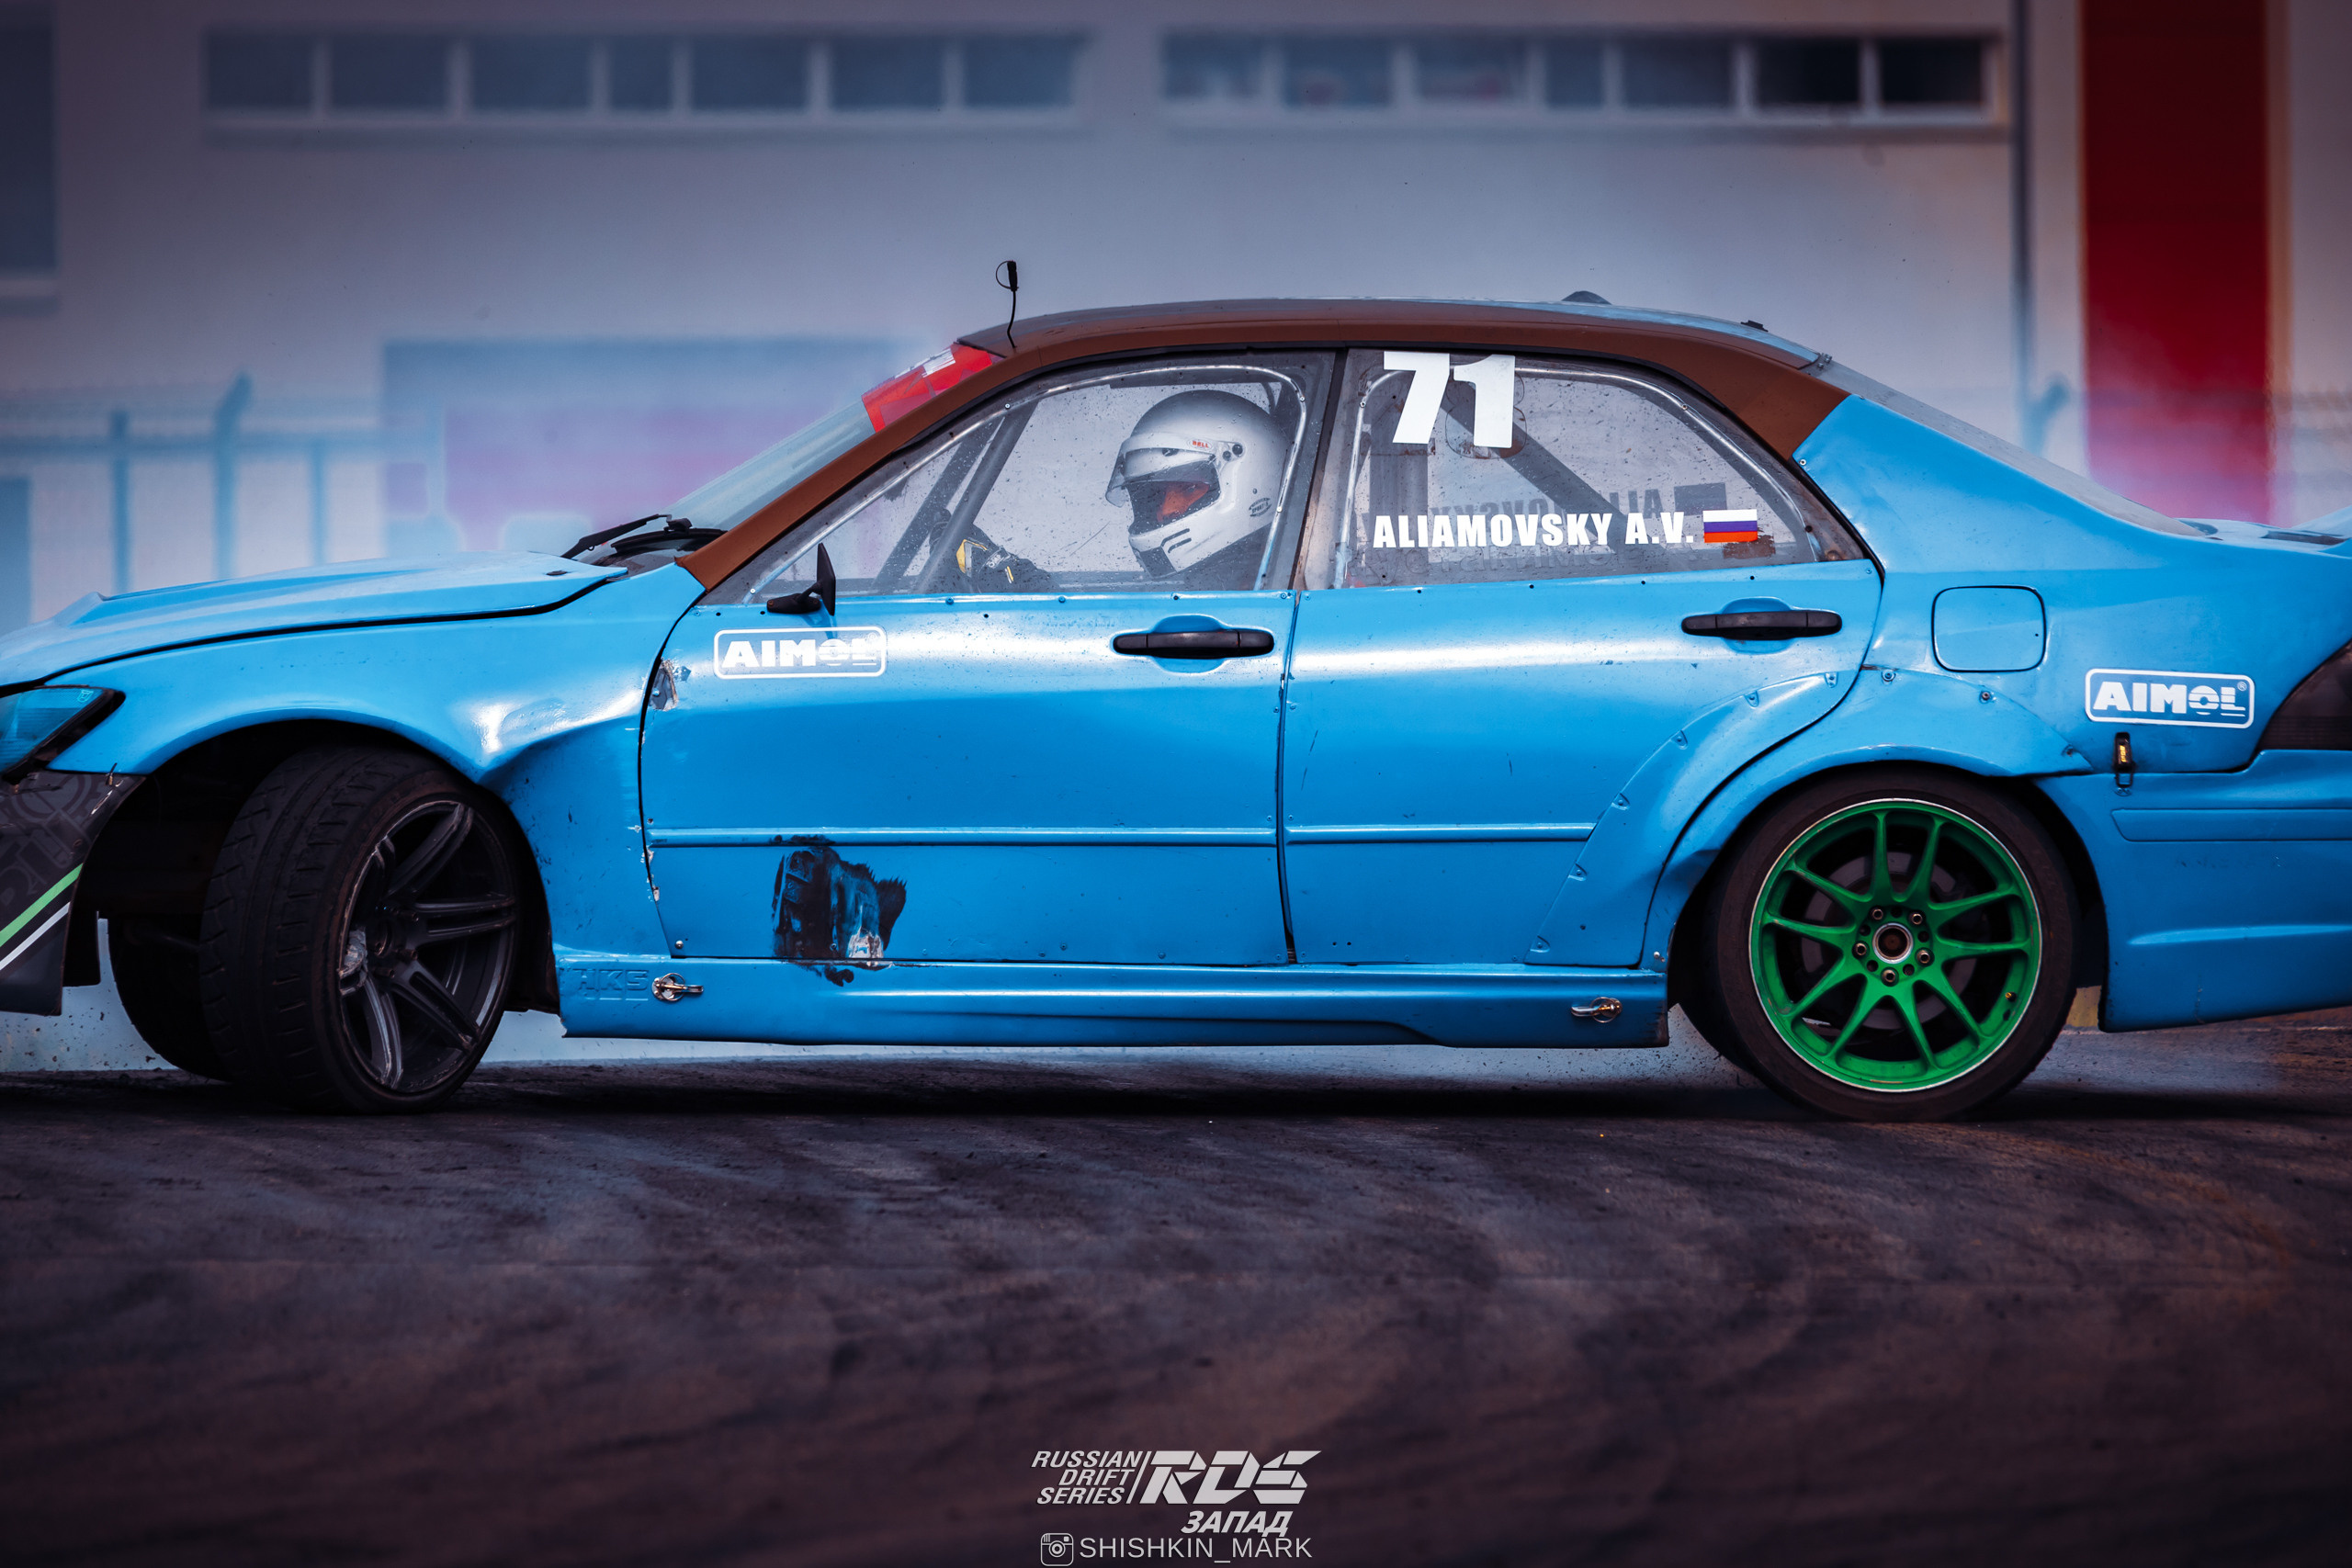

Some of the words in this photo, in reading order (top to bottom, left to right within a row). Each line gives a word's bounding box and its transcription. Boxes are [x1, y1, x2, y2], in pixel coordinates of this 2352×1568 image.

[1384, 351, 1516, 448] 71
[1192, 440, 1209, 449] BELL
[1373, 513, 1612, 548] ALIAMOVSKY
[1625, 511, 1694, 545] A.V.
[721, 637, 877, 669] AIMOL
[2093, 681, 2246, 717] AIMOL
